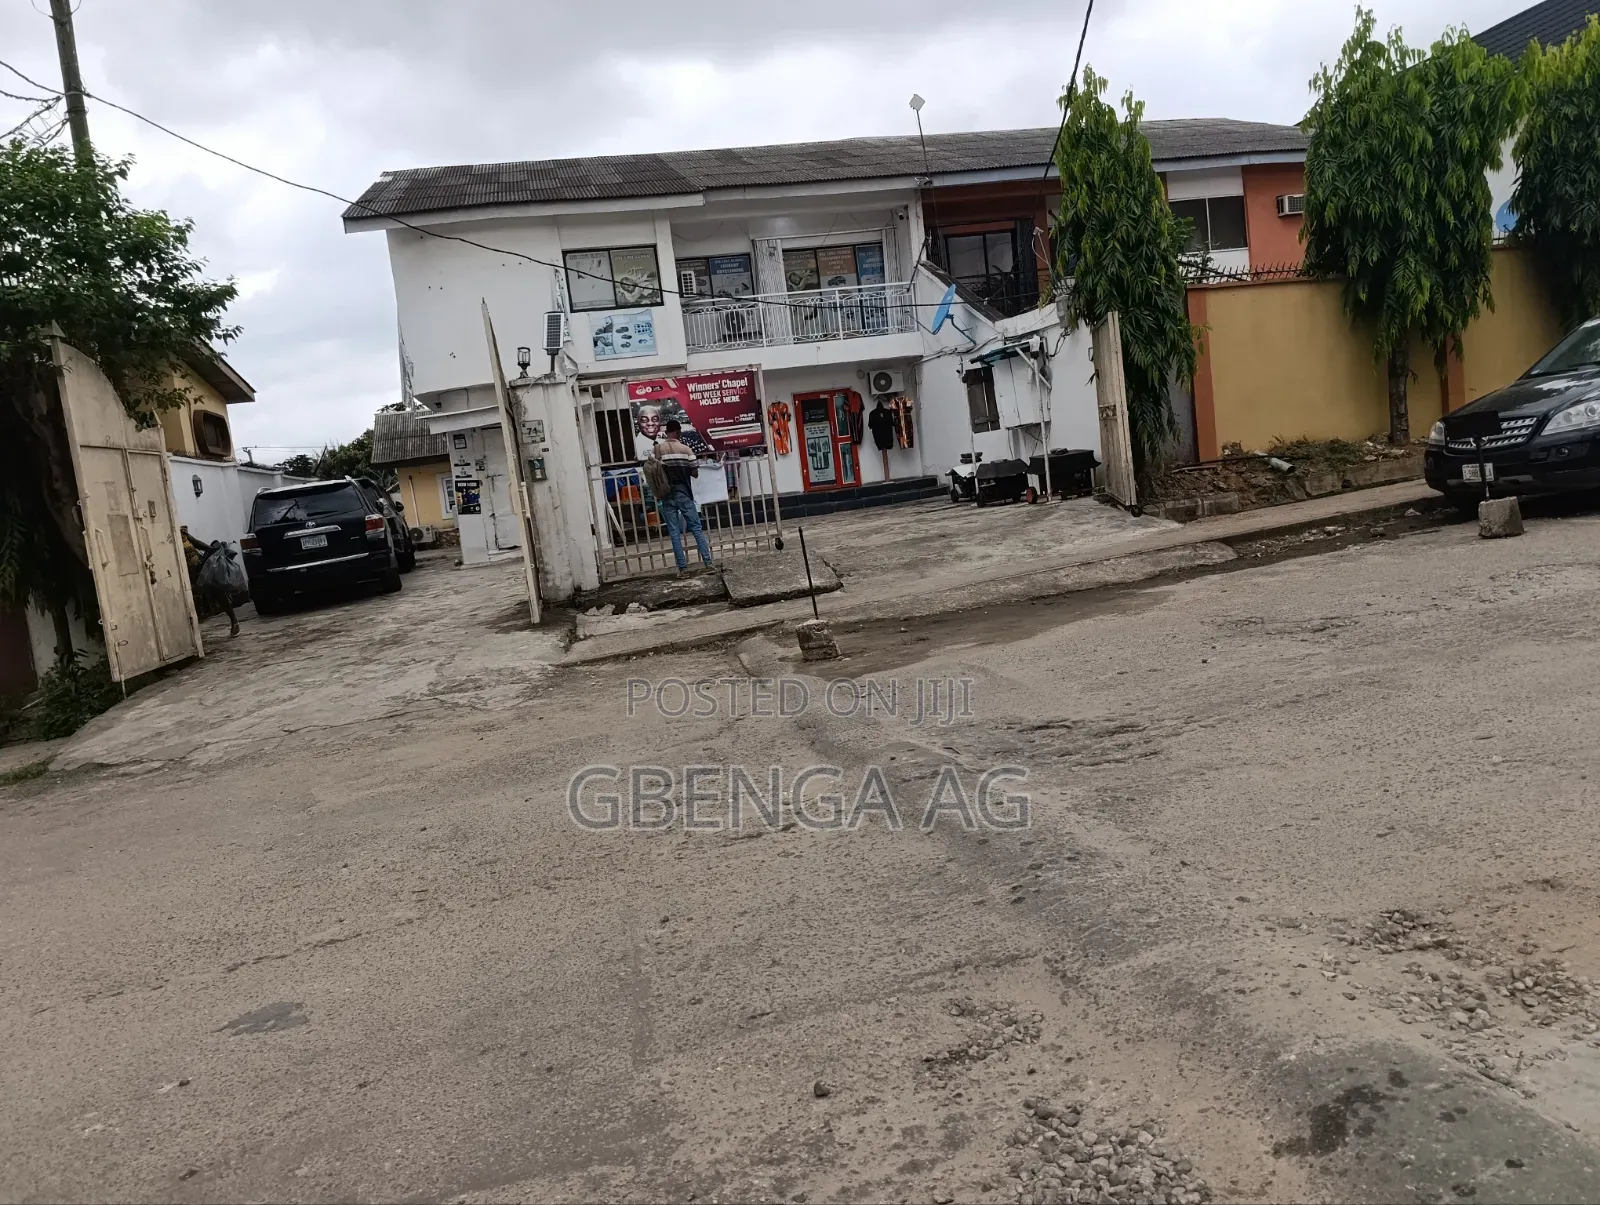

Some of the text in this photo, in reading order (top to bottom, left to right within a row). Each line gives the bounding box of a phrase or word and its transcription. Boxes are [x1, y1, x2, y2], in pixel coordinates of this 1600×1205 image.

[686, 377, 748, 392] Winners' Chapel
[690, 387, 748, 400] MID WEEK SERVICE
[699, 395, 740, 406] HOLDS HERE
